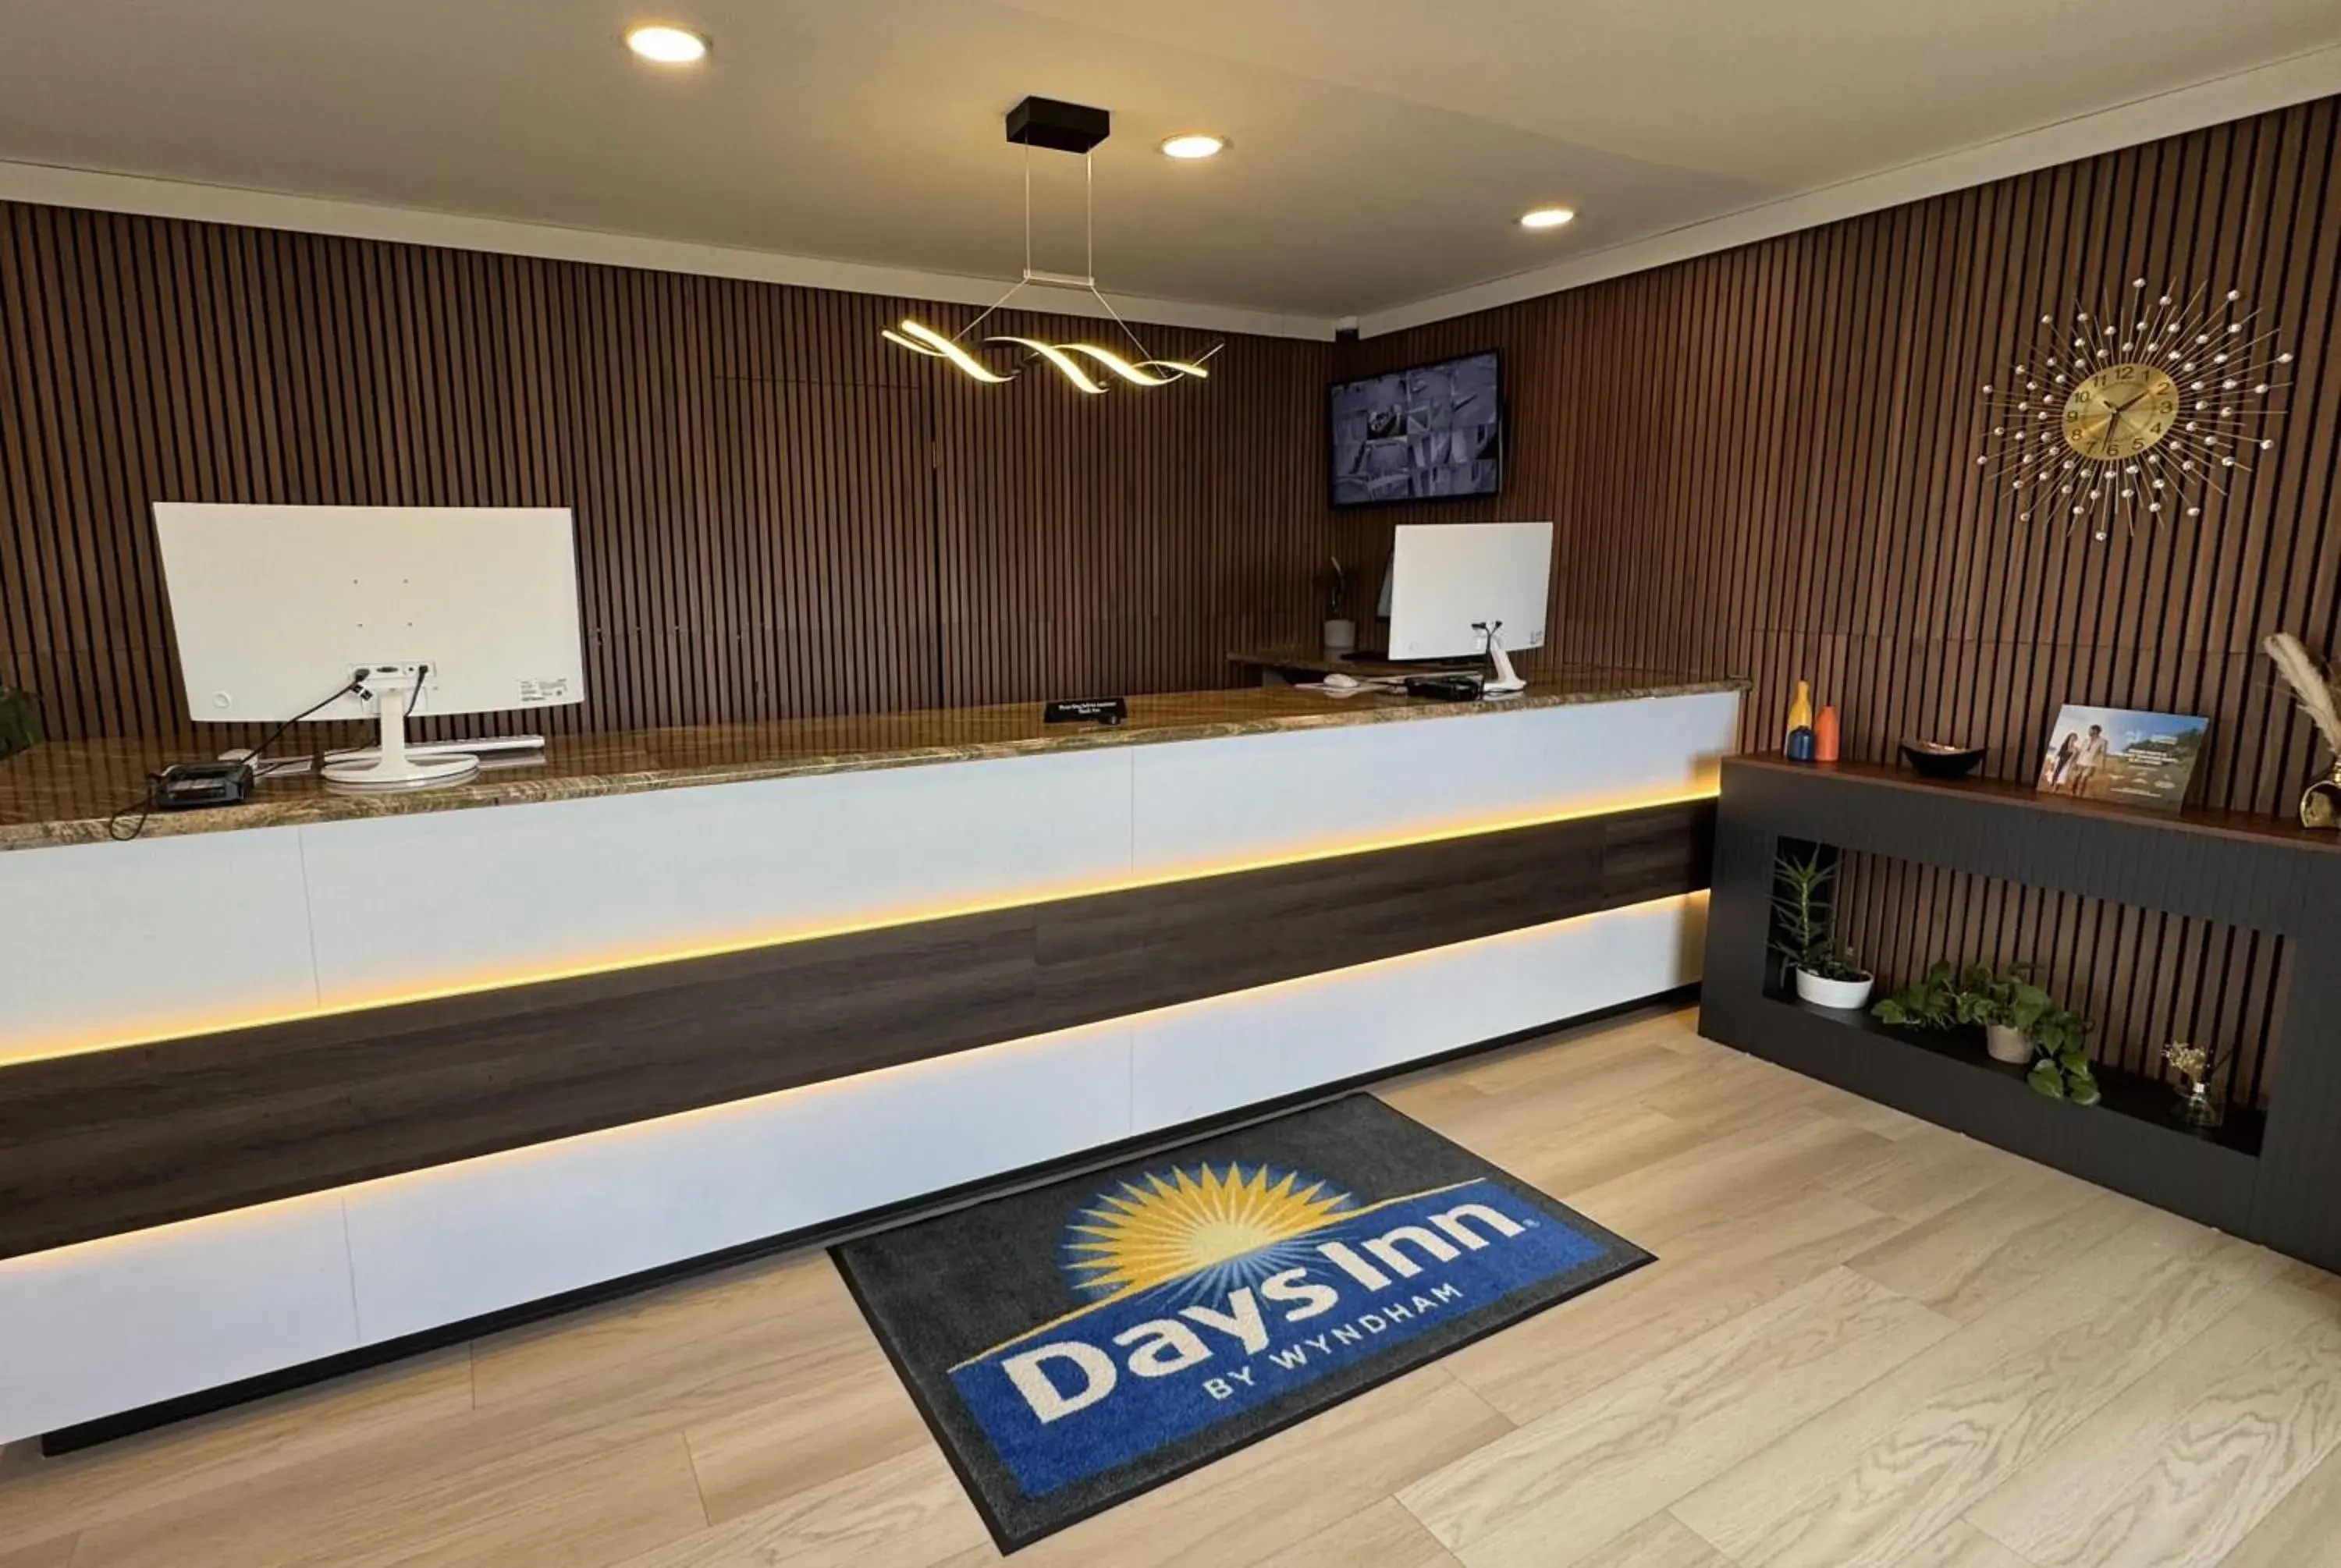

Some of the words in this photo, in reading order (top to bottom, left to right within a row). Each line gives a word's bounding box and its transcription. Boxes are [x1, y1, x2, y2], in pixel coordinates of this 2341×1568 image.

[2114, 366, 2135, 380] 12
[2092, 374, 2106, 388] 11
[2156, 382, 2170, 396] 2
[2073, 391, 2091, 403] 10
[2159, 400, 2172, 414] 3
[2067, 410, 2078, 423] 9
[2072, 428, 2083, 441] 8
[2150, 422, 2162, 434] 4
[2086, 441, 2097, 454] 7
[2107, 444, 2119, 456] 6
[2131, 438, 2144, 450] 5
[1001, 1268, 1339, 1424] Days
[1316, 1203, 1526, 1292] Inn
[1203, 1365, 1254, 1400] BY
[1269, 1282, 1463, 1370] WYNDHAM
